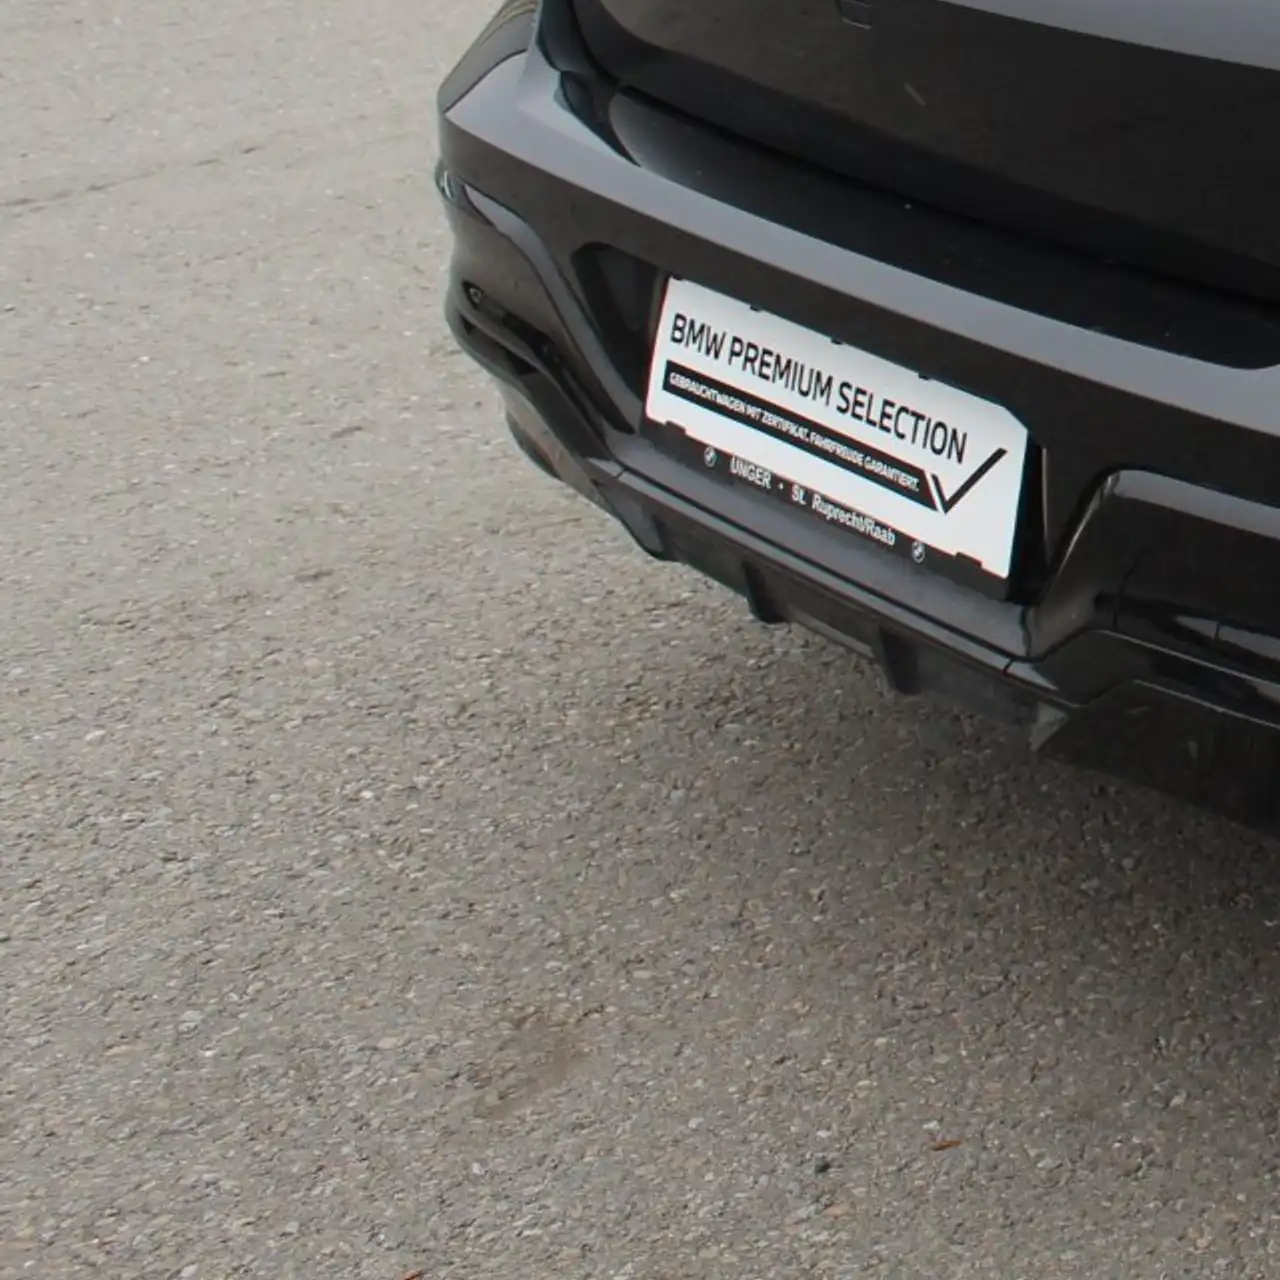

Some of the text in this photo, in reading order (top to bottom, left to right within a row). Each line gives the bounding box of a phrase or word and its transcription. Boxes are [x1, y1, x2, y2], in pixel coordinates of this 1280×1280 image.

[669, 313, 968, 465] BMW PREMIUM SELECTION
[730, 455, 772, 490] UNGER
